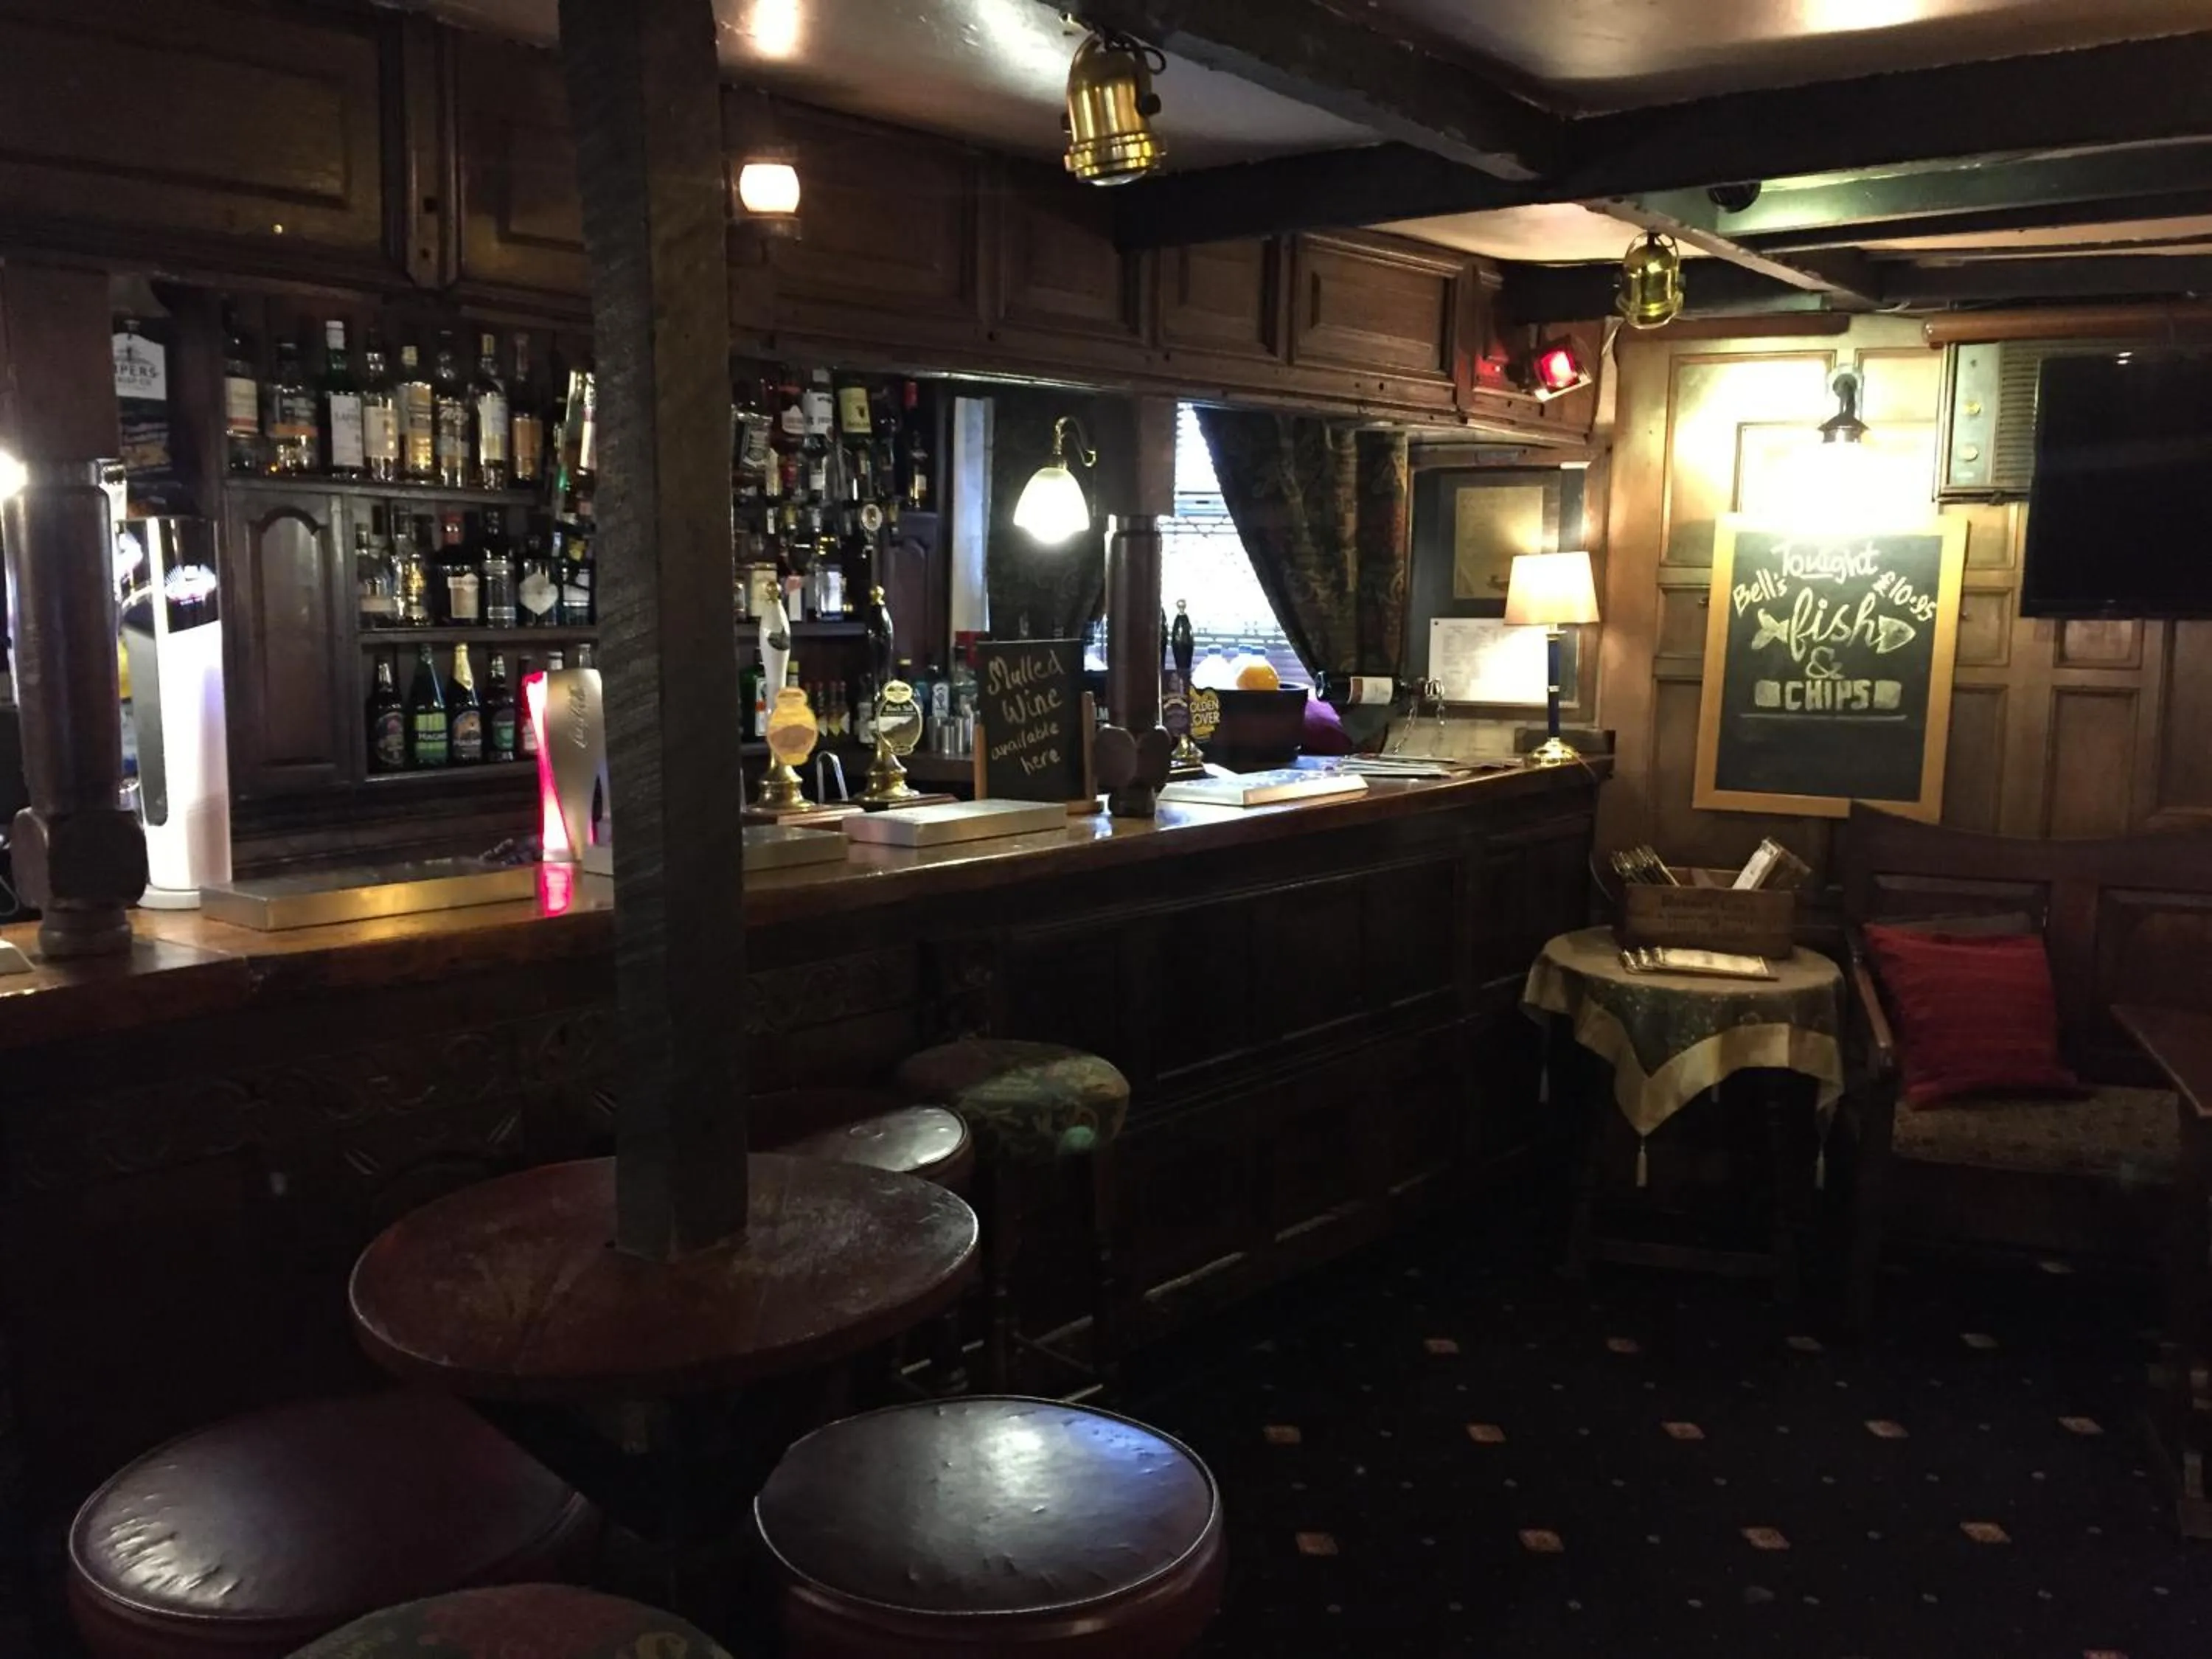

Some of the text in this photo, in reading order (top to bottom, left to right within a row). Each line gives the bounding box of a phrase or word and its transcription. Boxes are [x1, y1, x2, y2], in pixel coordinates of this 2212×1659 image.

[1770, 540, 1881, 585] Tonight
[1732, 568, 1788, 619] Bell's
[1789, 587, 1885, 662] fish
[987, 649, 1066, 695] Mulled
[1002, 688, 1064, 724] Wine
[1784, 678, 1872, 712] CHIPS
[991, 722, 1060, 761] available
[1020, 748, 1062, 776] here
